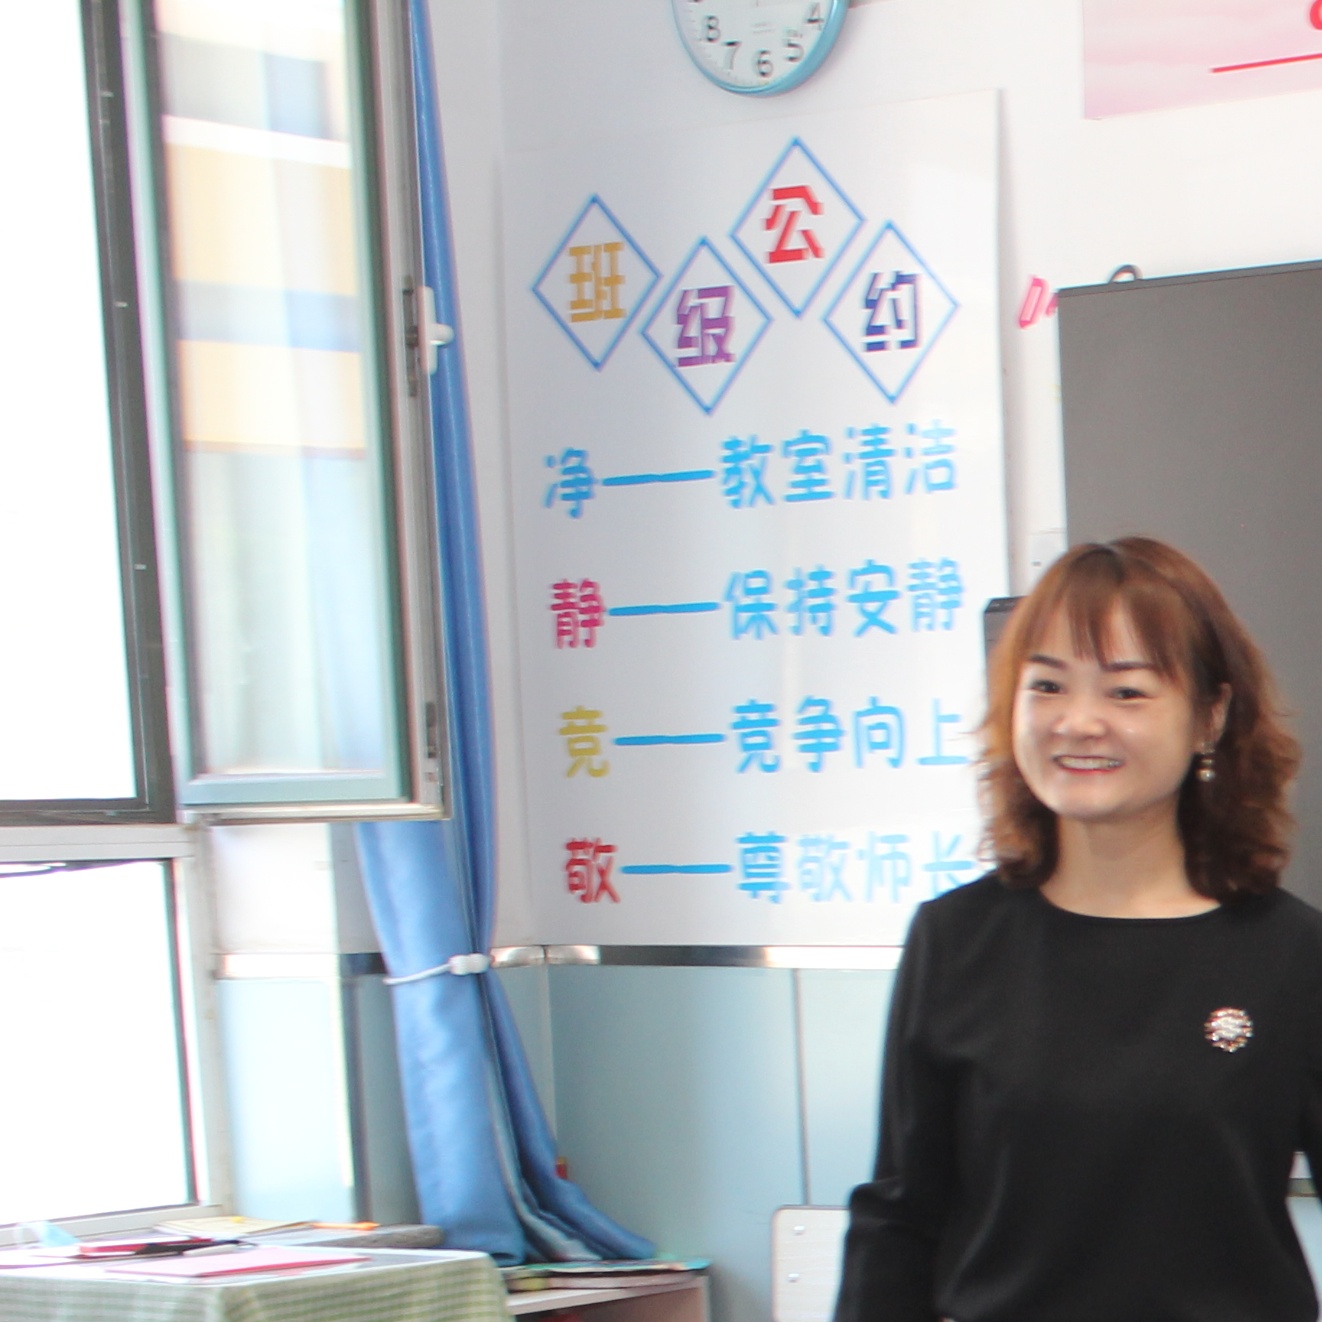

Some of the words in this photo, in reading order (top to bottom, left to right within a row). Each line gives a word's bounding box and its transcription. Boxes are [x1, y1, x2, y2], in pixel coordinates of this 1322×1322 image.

[706, 15, 721, 42] 8
[722, 40, 741, 71] 7
[757, 50, 774, 77] 6
